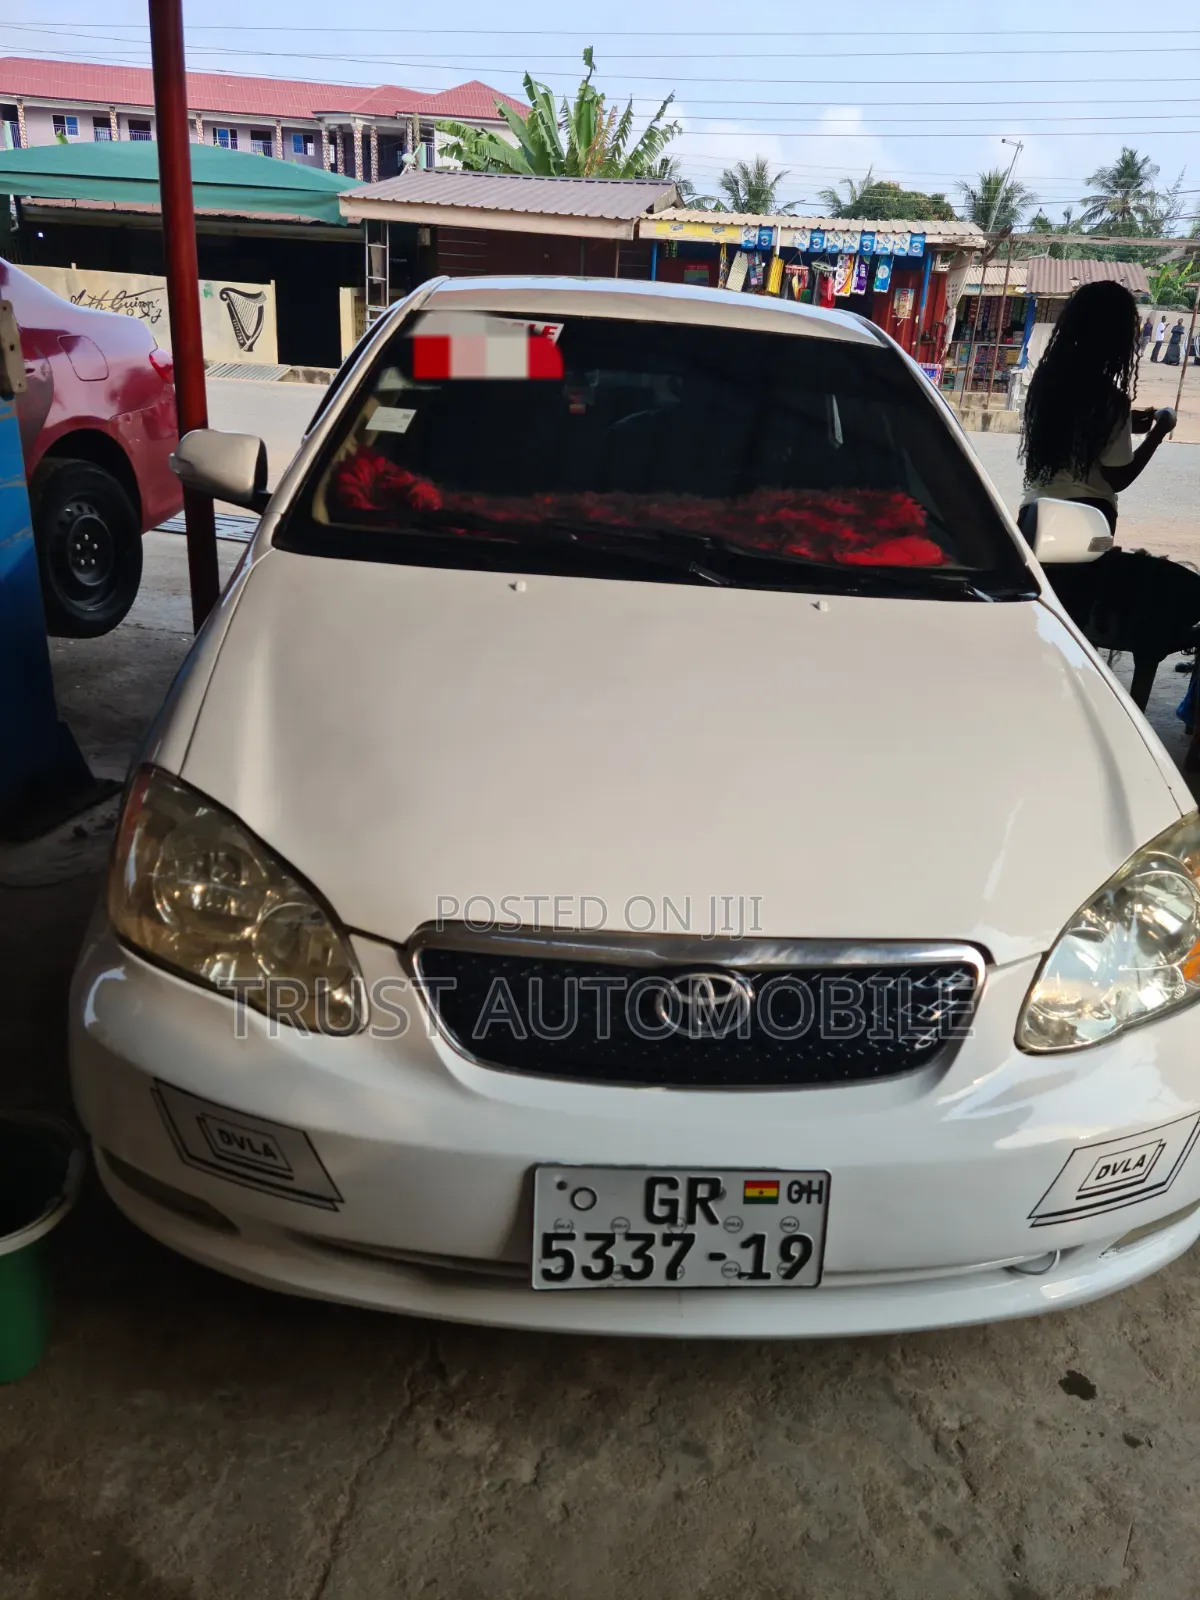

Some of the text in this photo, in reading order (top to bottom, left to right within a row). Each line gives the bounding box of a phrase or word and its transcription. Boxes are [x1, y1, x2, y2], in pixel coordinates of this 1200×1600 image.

[217, 1128, 278, 1160] DVLA
[1095, 1154, 1147, 1181] DVLA
[645, 1176, 824, 1225] GR GH
